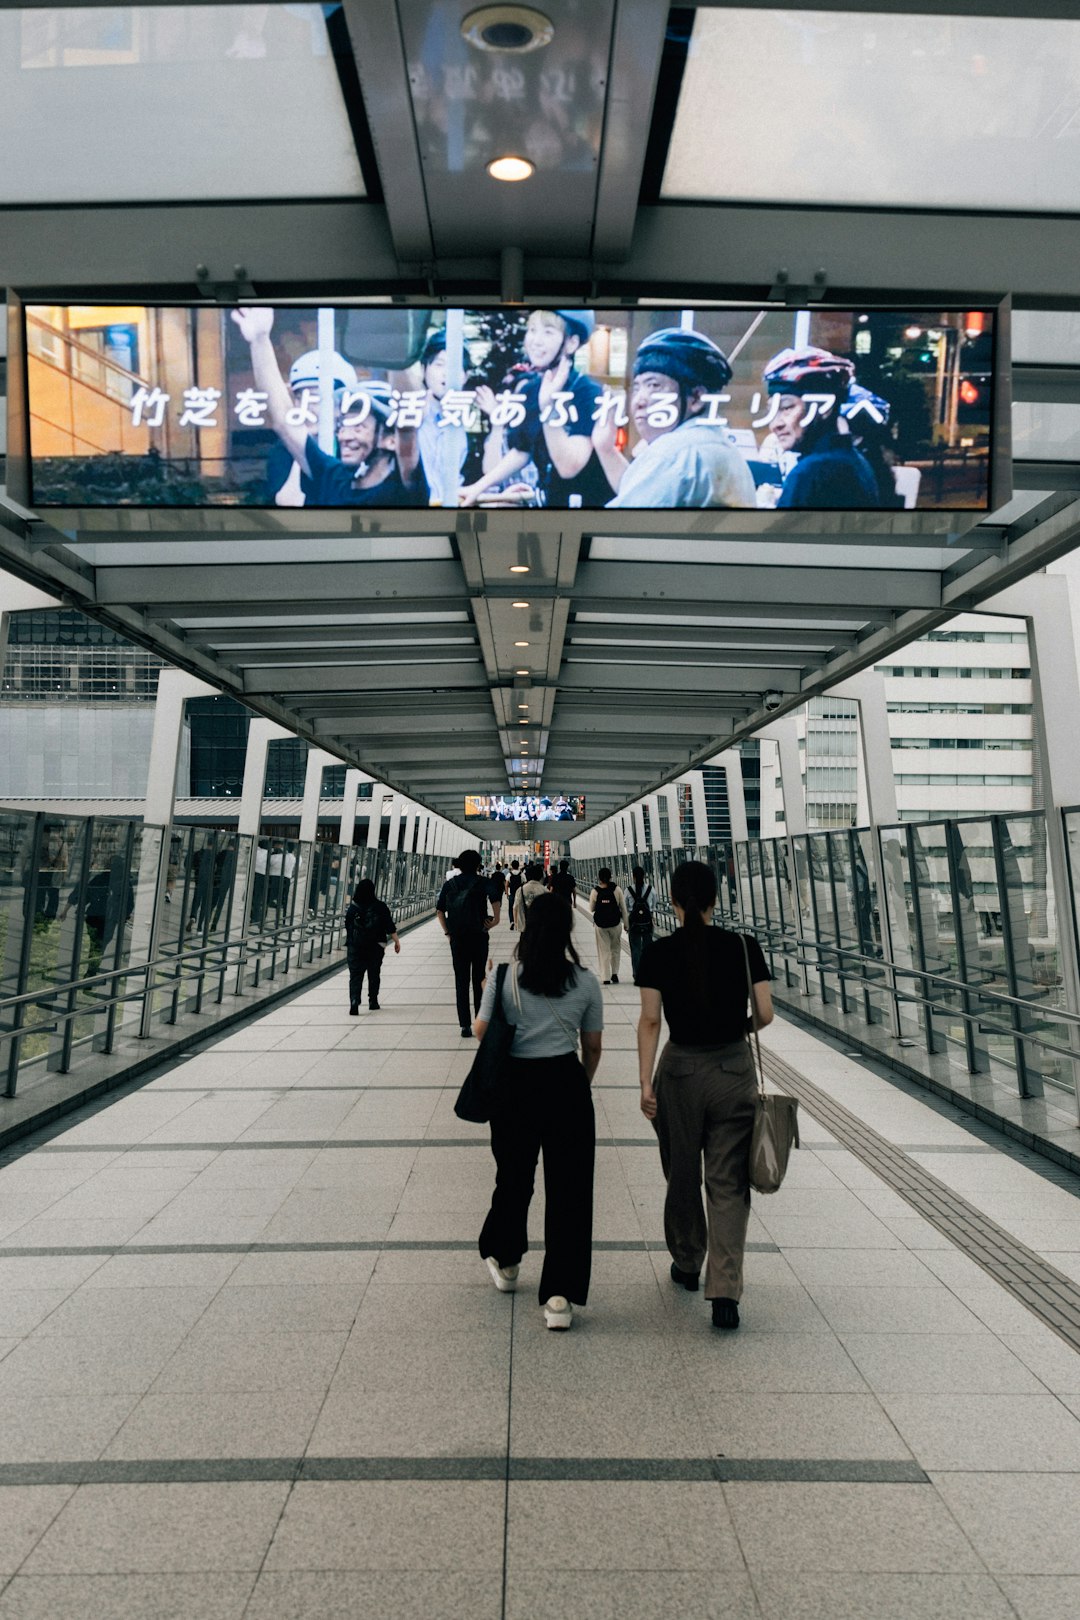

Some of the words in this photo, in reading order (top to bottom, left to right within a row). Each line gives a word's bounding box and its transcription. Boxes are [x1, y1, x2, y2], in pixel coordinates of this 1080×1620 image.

[130, 388, 885, 427] 竹芝をより活気あふれるエリアへ
